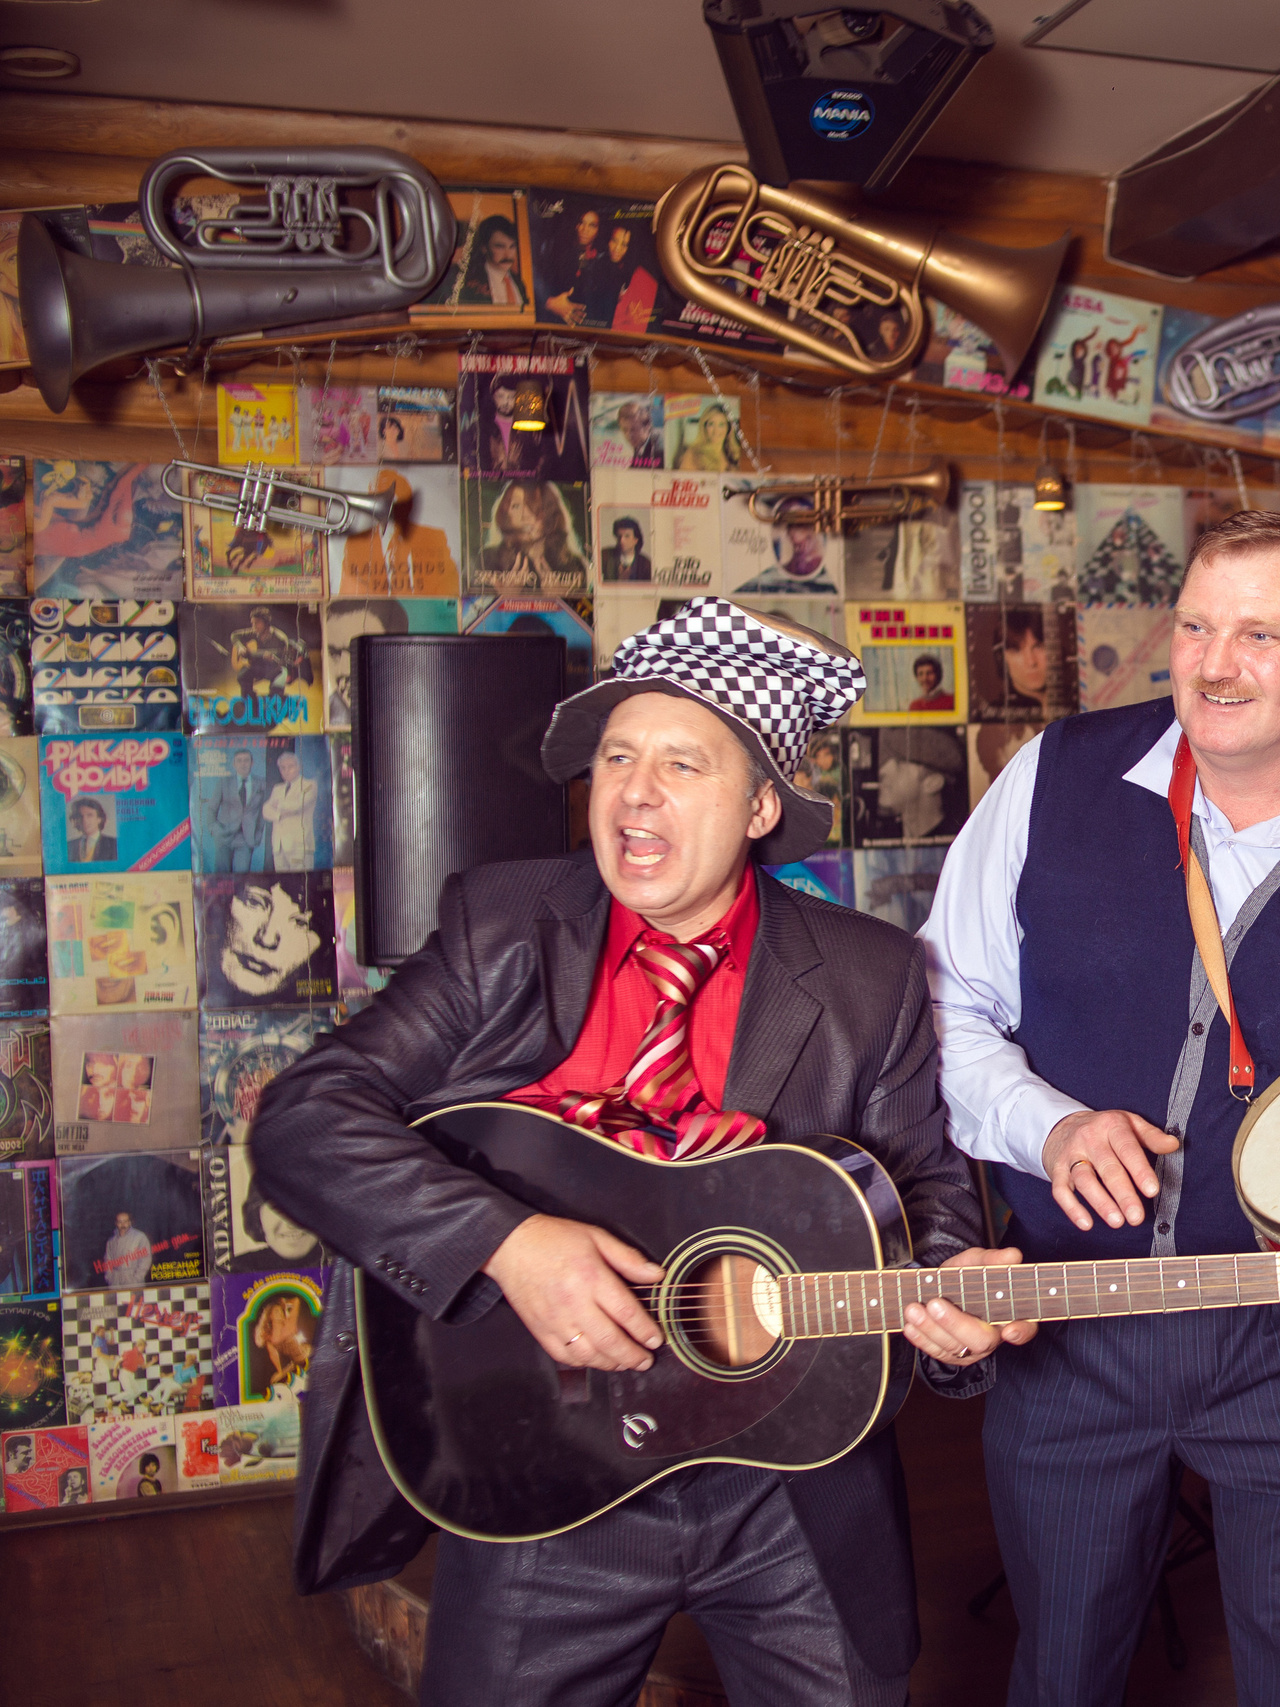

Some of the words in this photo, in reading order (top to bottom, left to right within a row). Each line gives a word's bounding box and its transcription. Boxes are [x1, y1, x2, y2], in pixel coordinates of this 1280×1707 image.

[813, 107, 870, 121] MANIA
[965, 486, 991, 597] liverpool
[44, 738, 170, 773] РИККАРДО
[56, 761, 149, 800] ФОЛЬИ
[55, 1124, 90, 1141] БИТЛЗ
[31, 1169, 50, 1289] ФАНТАСТИКА
[208, 1157, 231, 1272] ADAMO
